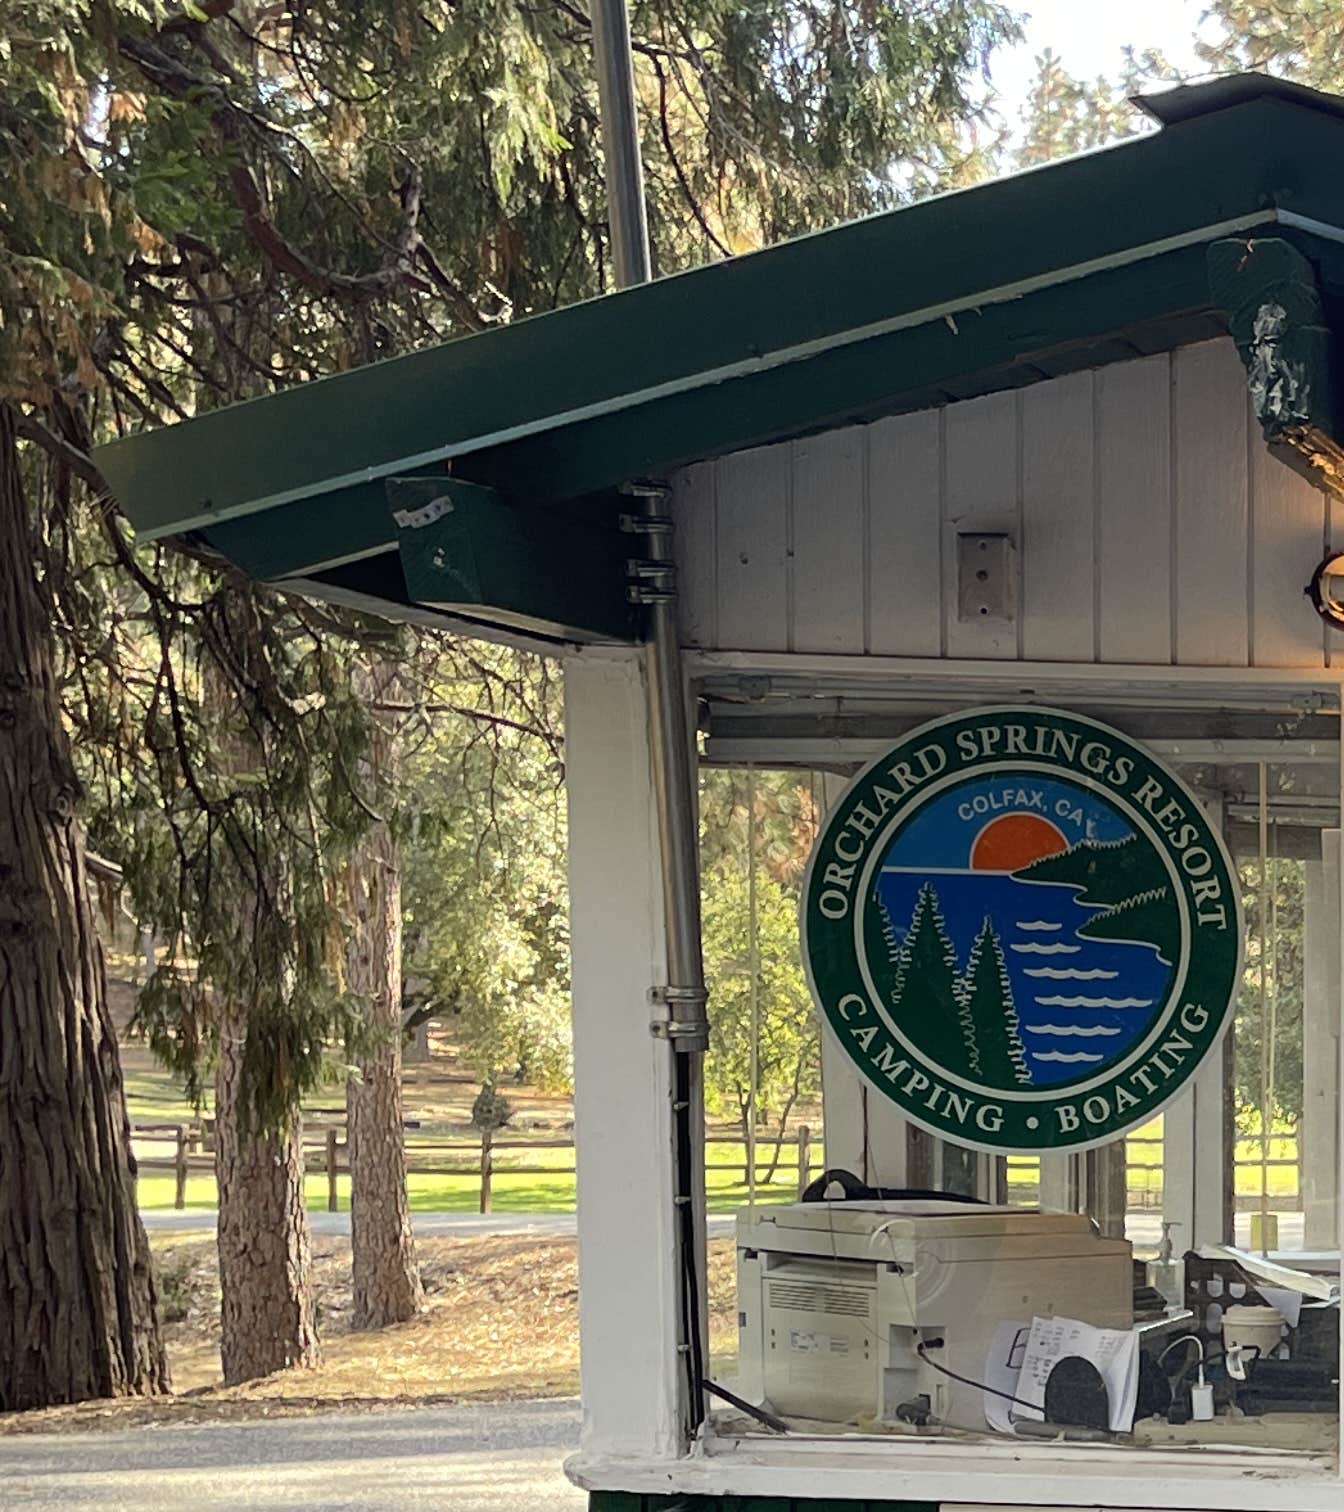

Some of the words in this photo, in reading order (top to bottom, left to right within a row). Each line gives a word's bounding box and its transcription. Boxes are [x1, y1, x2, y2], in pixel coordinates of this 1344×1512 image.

[818, 742, 948, 920] ORCHARD
[955, 724, 1136, 787] SPRINGS
[1132, 774, 1228, 931] RESORT
[957, 788, 1049, 821] COLFAX,
[837, 993, 1005, 1133] CAMPING
[1055, 1002, 1210, 1134] BOATING
